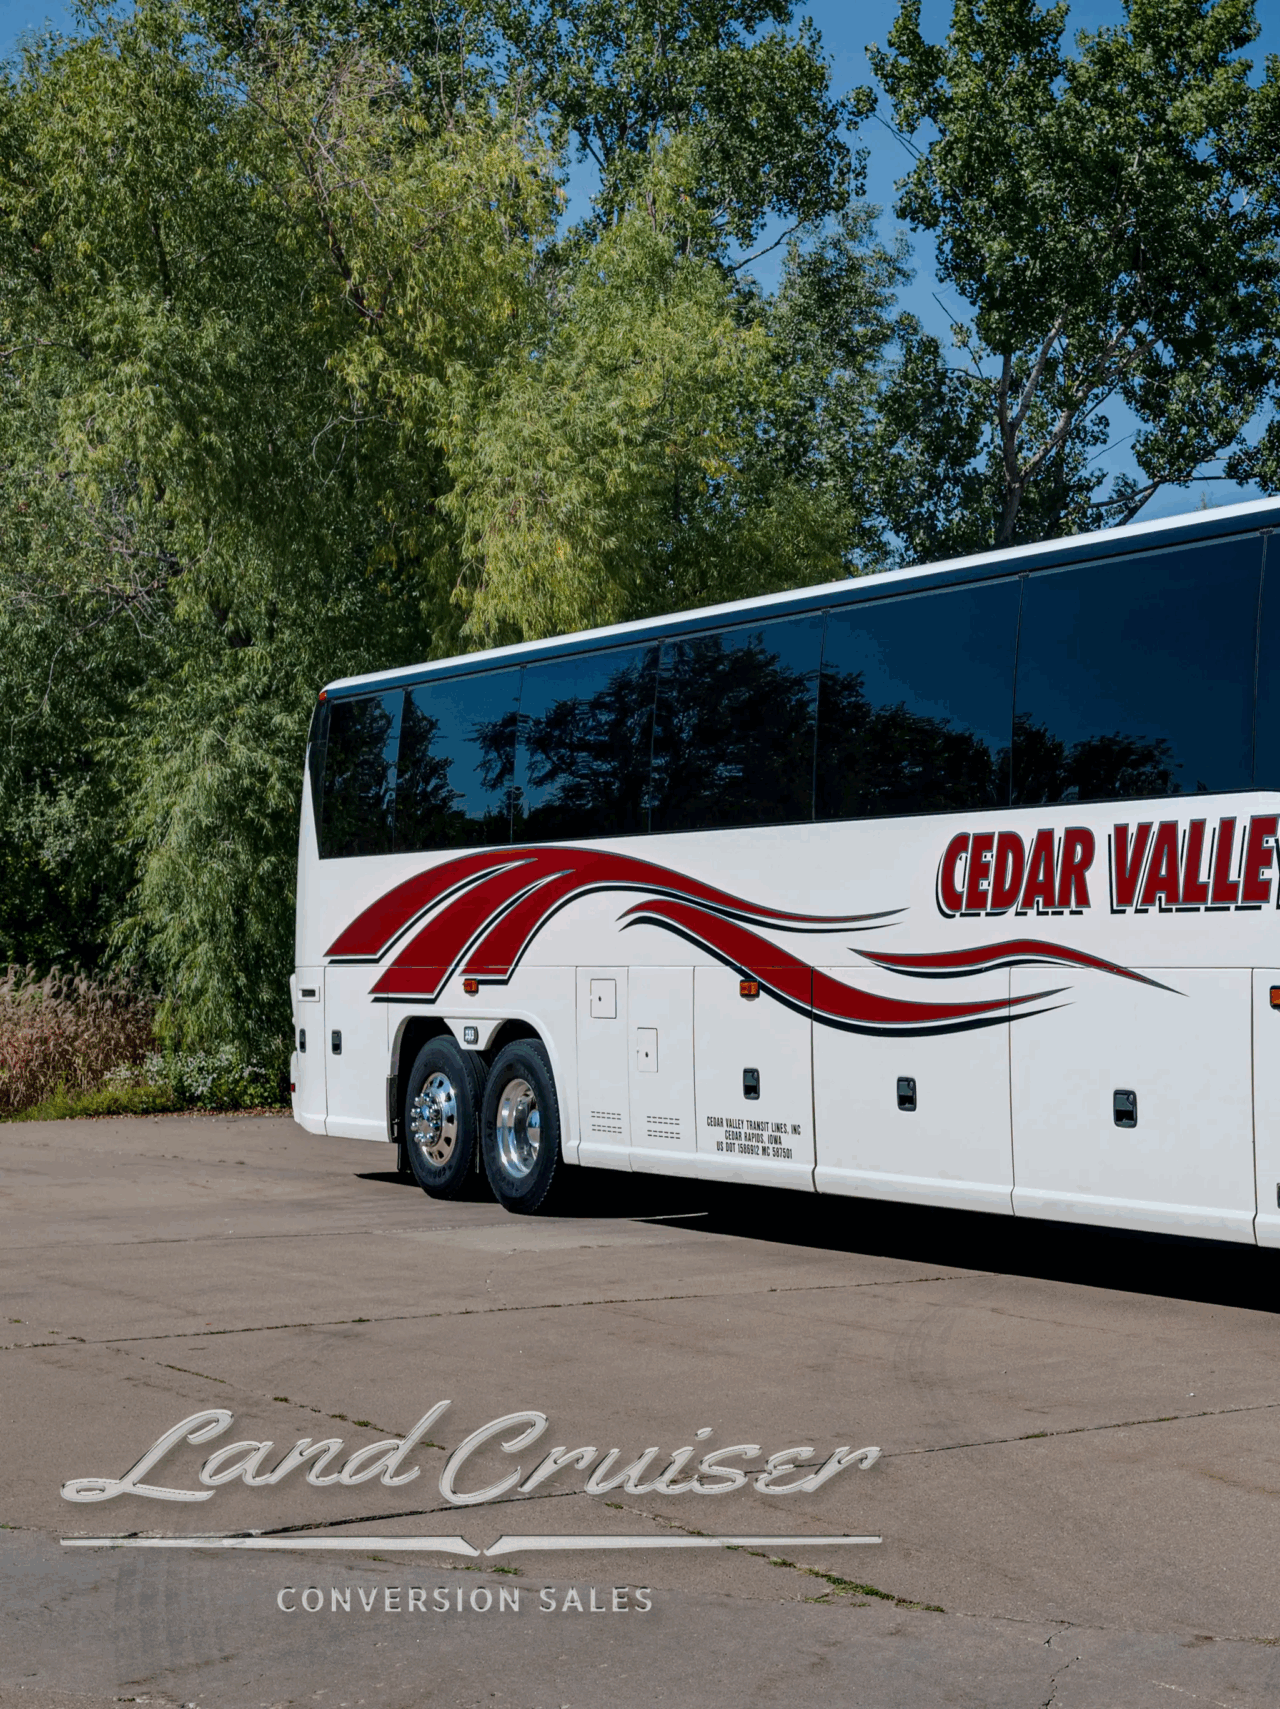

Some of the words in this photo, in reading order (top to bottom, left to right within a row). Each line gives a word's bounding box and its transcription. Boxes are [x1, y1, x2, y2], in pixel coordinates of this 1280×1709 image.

[935, 826, 1096, 919] CEDAR
[706, 1115, 724, 1128] CEDAR
[725, 1117, 745, 1130] VALLEY
[746, 1119, 770, 1132] TRANSIT
[771, 1121, 789, 1135] LINES,
[724, 1129, 743, 1142] CEDAR
[744, 1131, 766, 1144] RAPIDS,
[767, 1133, 783, 1146] IOWA
[716, 1141, 724, 1152] US
[725, 1141, 736, 1153] DOT
[761, 1145, 771, 1157] MC
